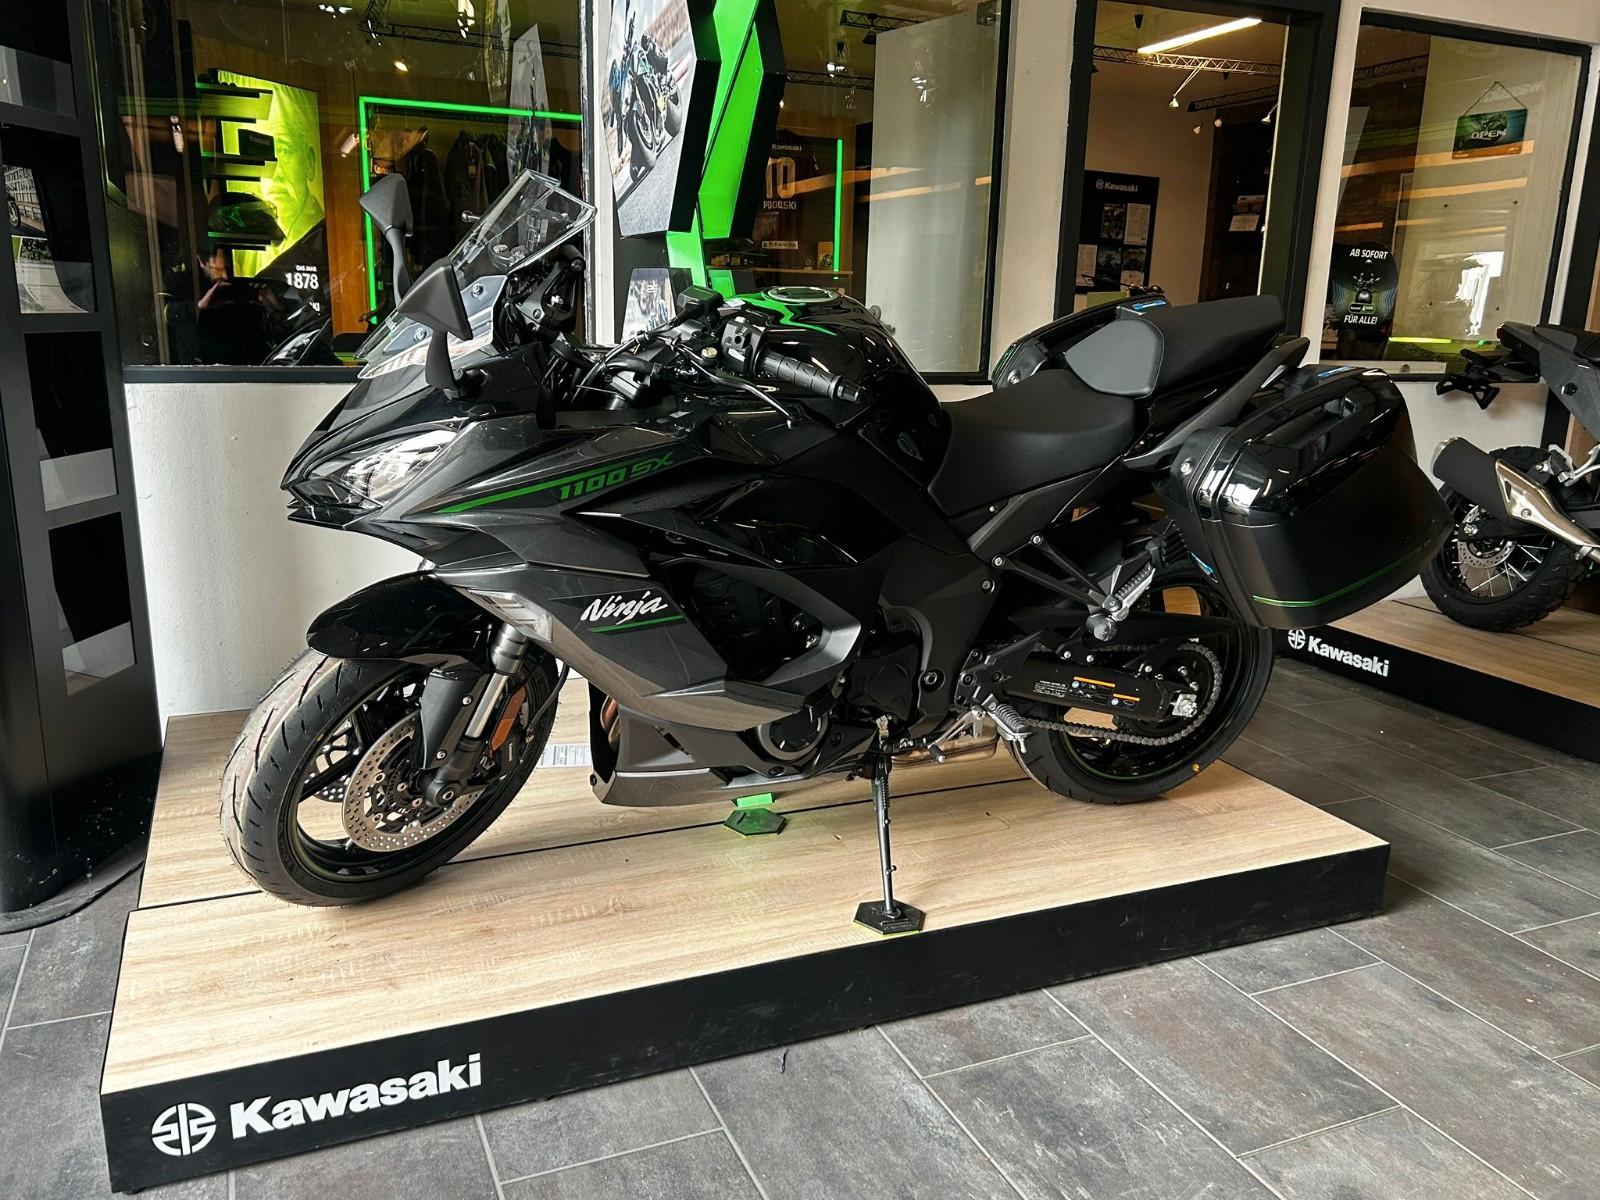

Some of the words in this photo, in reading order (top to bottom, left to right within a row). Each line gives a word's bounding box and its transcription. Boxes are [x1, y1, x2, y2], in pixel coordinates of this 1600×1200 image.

[1471, 129, 1507, 141] OPEN
[765, 156, 796, 199] 10
[1104, 181, 1138, 192] Kawasaki
[1349, 248, 1360, 257] AB
[1361, 249, 1388, 259] SOFORT
[285, 271, 319, 290] 1878
[1344, 314, 1358, 323] FÜR
[1358, 315, 1378, 325] ALLE!
[560, 467, 628, 500] 1100
[630, 451, 673, 478] SX
[580, 590, 669, 626] Ninja
[1308, 634, 1390, 677] Kawasaki
[230, 1053, 482, 1139] Kawasaki
